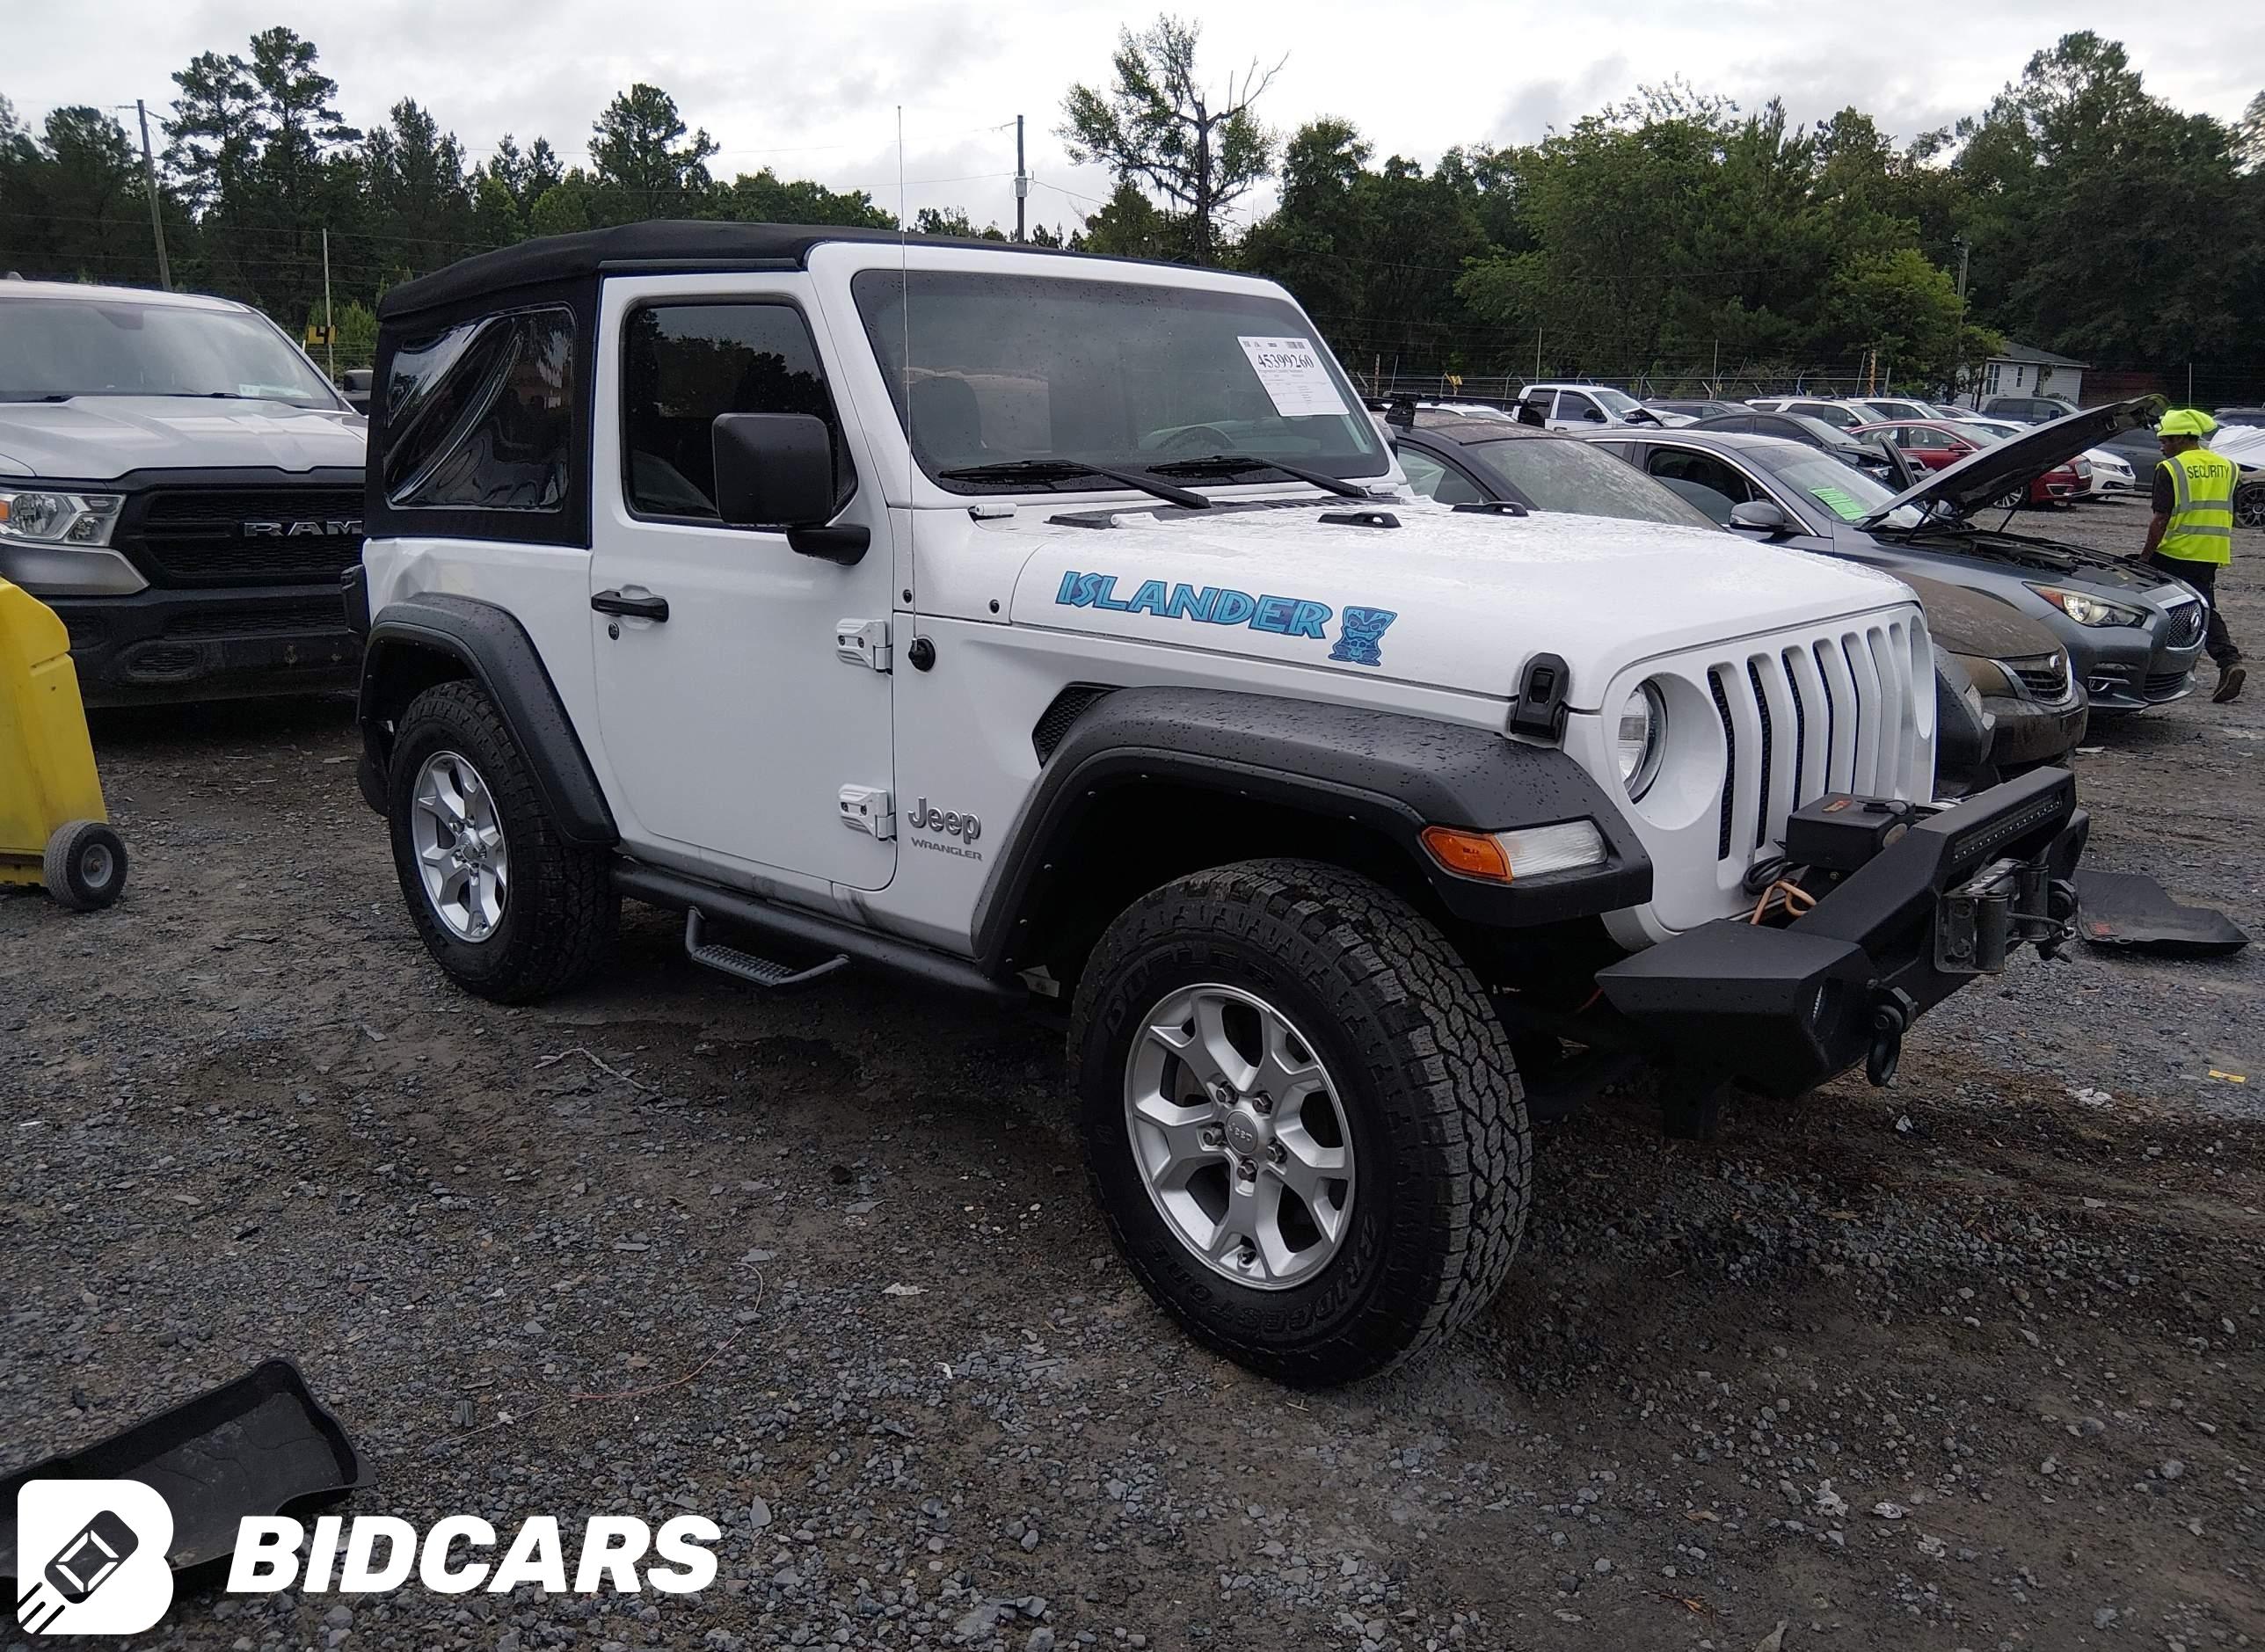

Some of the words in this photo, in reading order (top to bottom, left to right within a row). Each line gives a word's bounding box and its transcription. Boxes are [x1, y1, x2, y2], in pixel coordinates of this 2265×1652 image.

[1257, 353, 1315, 368] 45399260
[2187, 464, 2231, 479] SECURITY
[244, 520, 364, 536] RAM
[1054, 571, 1334, 640] ISLANDER
[907, 796, 982, 845] Jeep
[911, 836, 983, 862] WRANGLER
[1145, 1212, 1379, 1334] BRIDGESTONE
